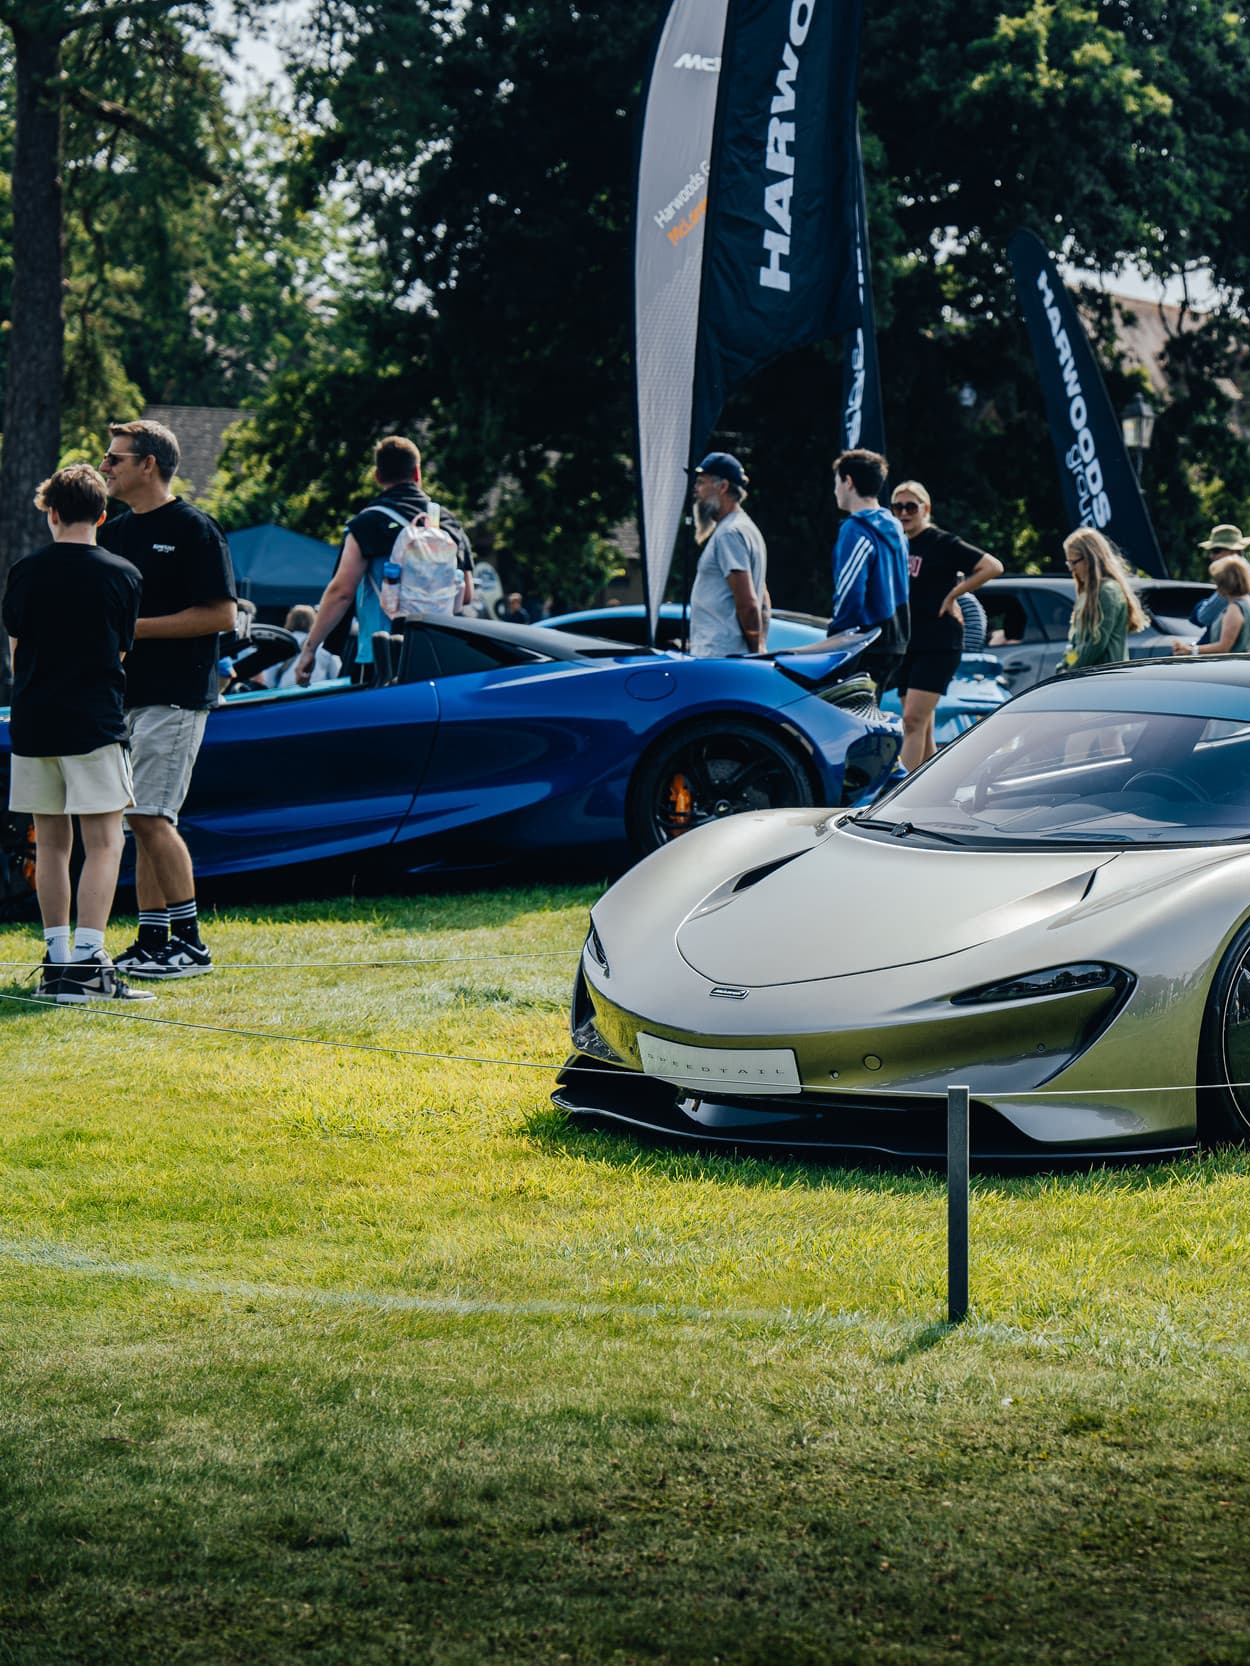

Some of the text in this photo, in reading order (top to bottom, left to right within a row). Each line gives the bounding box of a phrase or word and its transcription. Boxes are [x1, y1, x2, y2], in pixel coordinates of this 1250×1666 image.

[653, 171, 706, 230] Harwoods
[1036, 269, 1112, 529] HARWOODS
[647, 1053, 785, 1075] SPEEDTAIL
